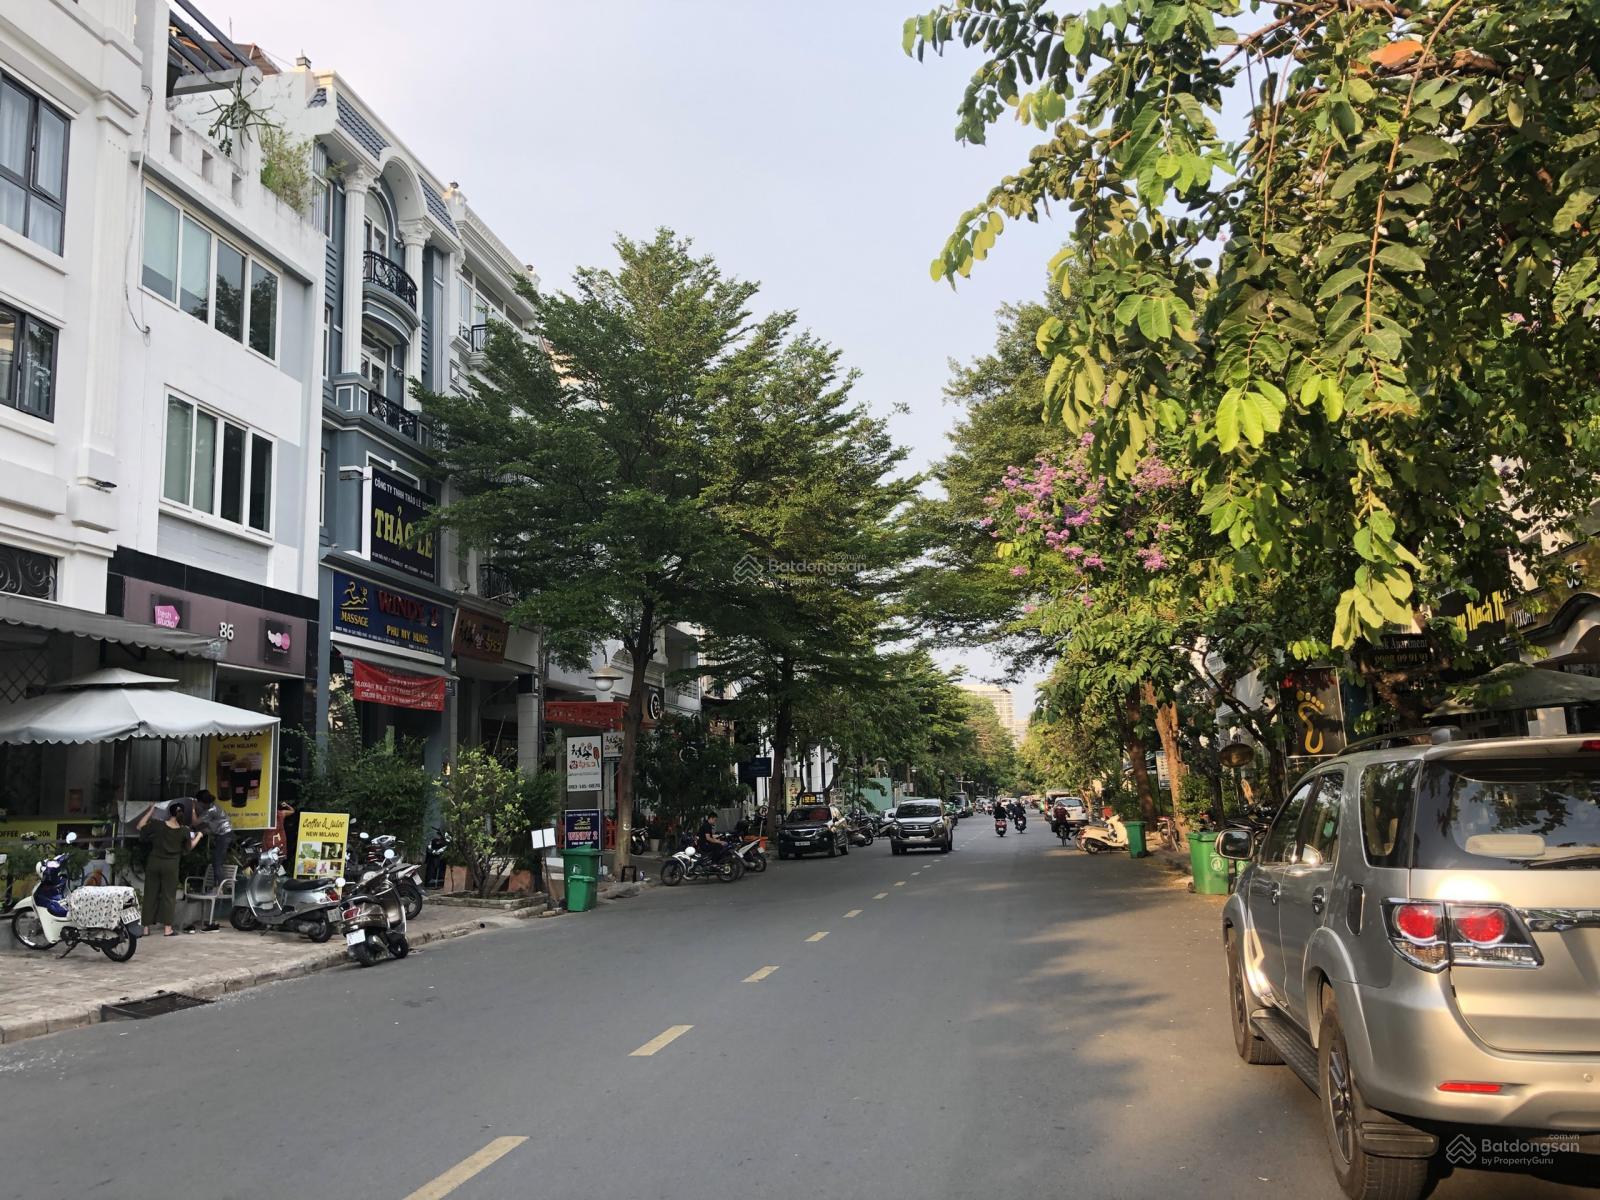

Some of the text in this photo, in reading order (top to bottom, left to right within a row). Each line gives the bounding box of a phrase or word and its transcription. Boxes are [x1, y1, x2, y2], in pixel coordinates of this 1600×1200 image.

[374, 505, 414, 551] THẢO
[157, 608, 172, 619] fresh
[341, 610, 369, 628] MASSAGE
[219, 621, 234, 640] 86
[400, 629, 411, 640] MY
[302, 818, 321, 829] Coffee
